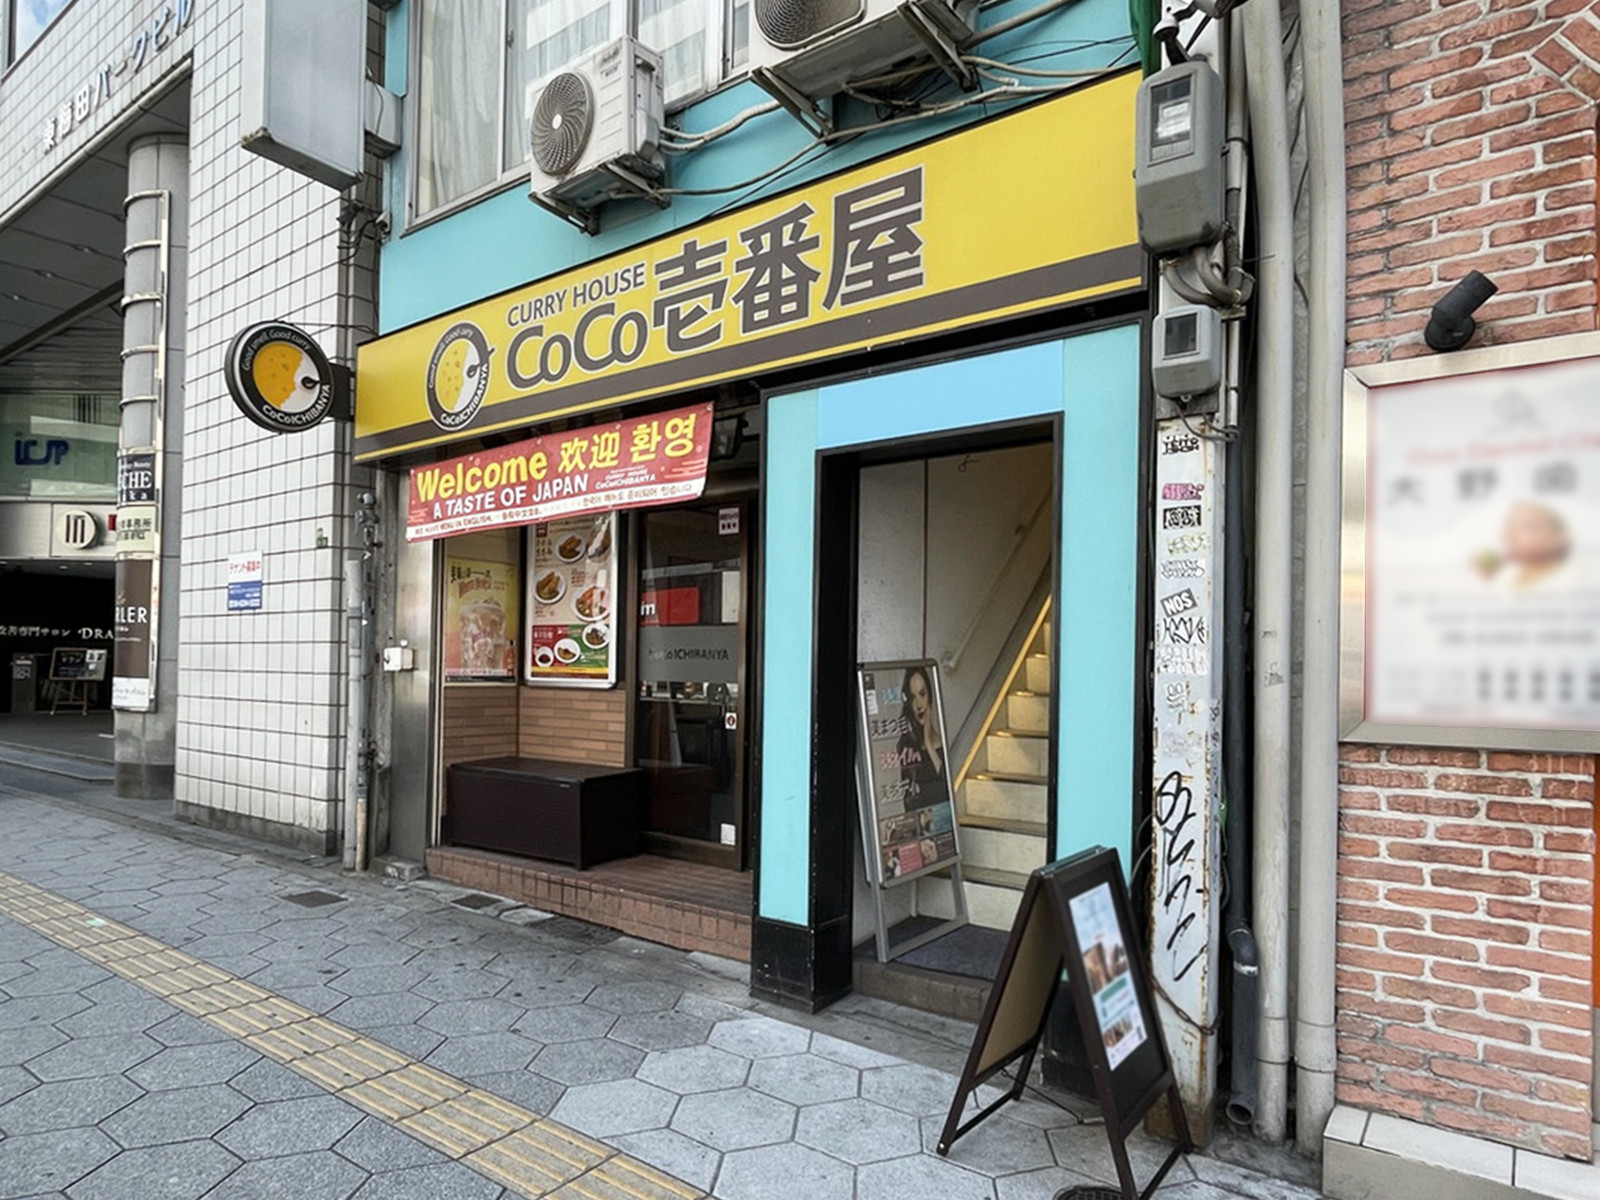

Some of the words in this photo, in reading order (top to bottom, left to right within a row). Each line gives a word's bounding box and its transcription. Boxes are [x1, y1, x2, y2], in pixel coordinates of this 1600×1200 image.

[506, 165, 925, 389] CoCo壱番屋
[507, 289, 568, 327] CURRY
[572, 262, 647, 308] HOUSE
[269, 329, 291, 339] Good
[417, 452, 548, 502] Welcome
[557, 431, 620, 473] 欢迎
[630, 413, 696, 463] 환영
[433, 502, 442, 519] A
[445, 490, 496, 516] TASTE
[500, 486, 527, 506] OF
[532, 473, 589, 502] JAPAN
[1162, 591, 1194, 616] NOS
